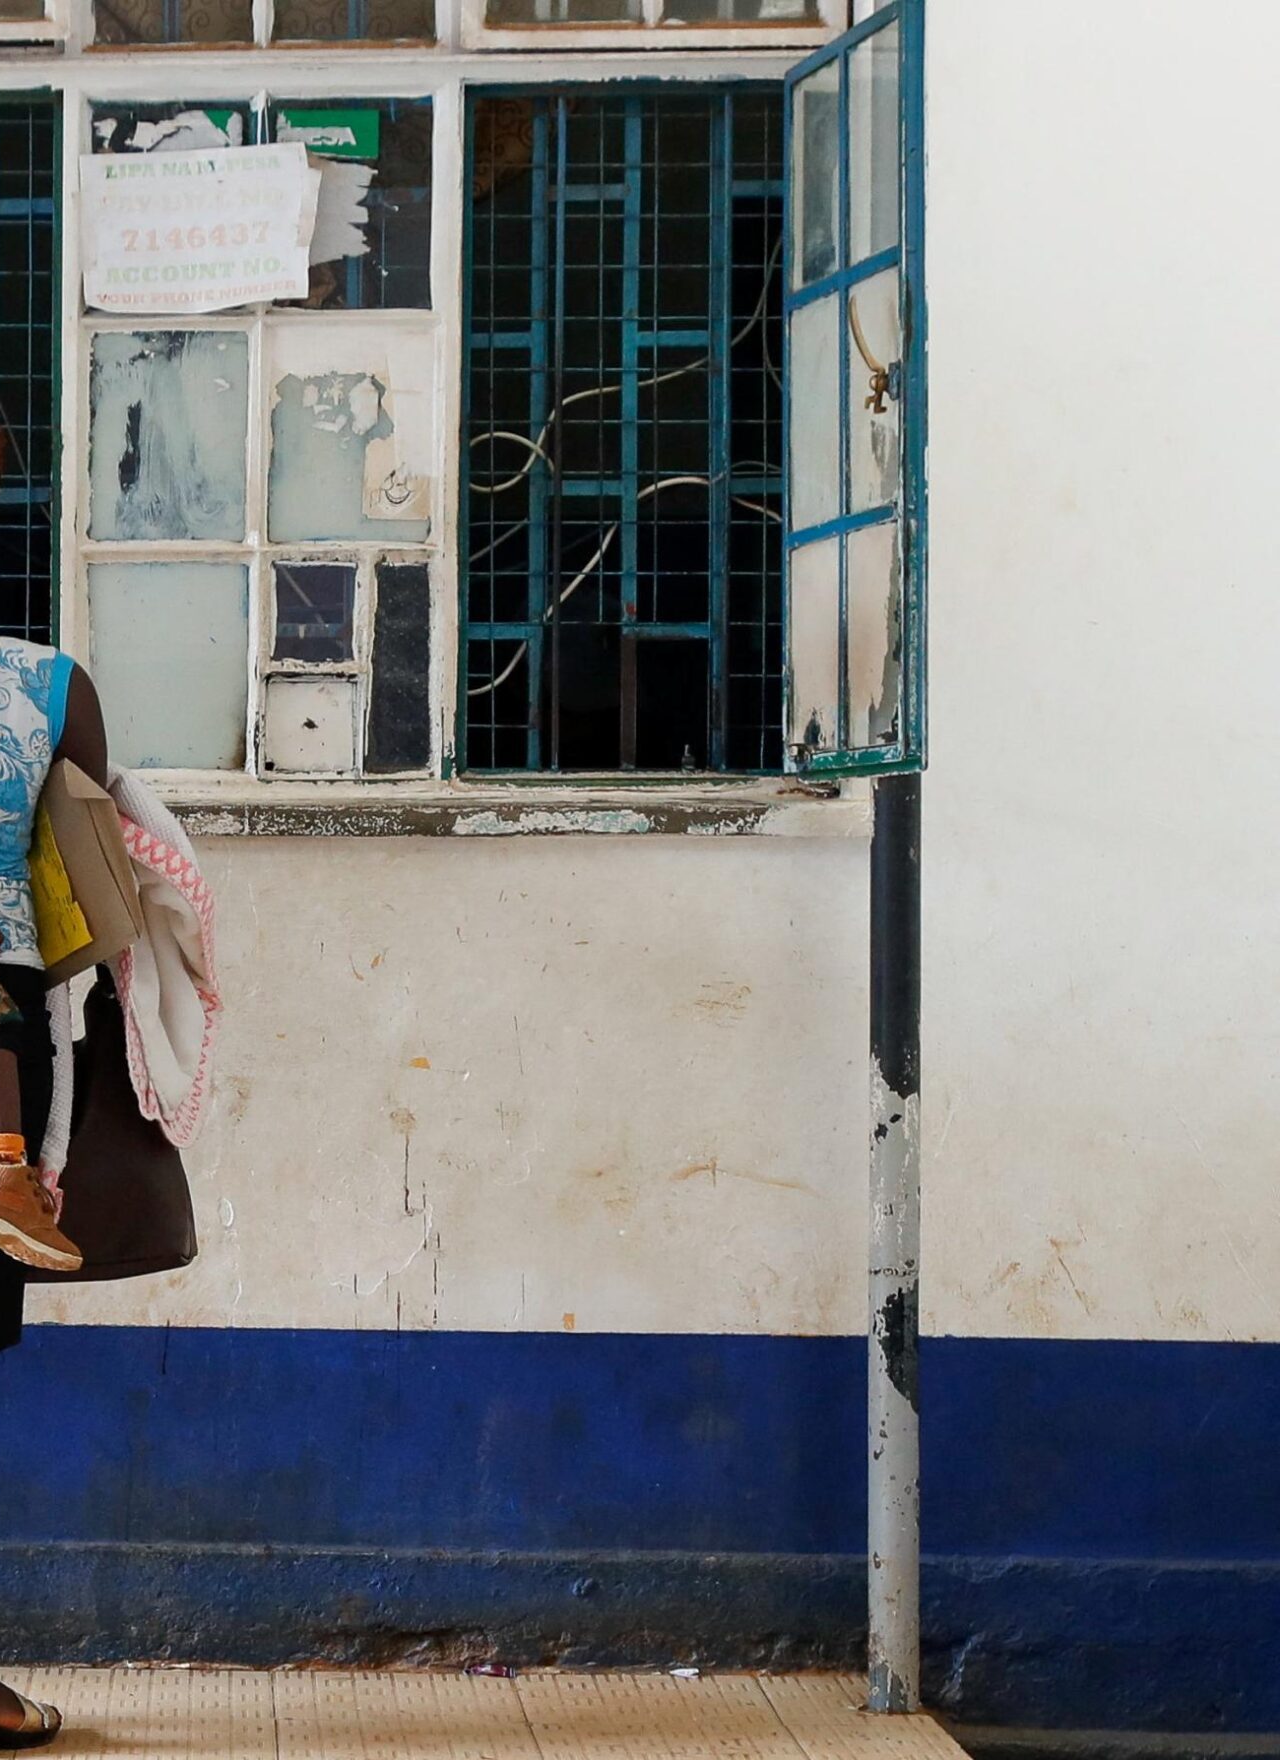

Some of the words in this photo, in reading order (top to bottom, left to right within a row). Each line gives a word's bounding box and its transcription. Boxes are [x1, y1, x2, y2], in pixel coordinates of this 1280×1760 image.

[104, 163, 156, 180] LIPA
[161, 161, 192, 177] NA
[122, 221, 271, 252] 7146437
[106, 261, 236, 284] ACCOUNT
[97, 292, 145, 305] YOUR
[149, 289, 215, 305] PHONE
[219, 278, 297, 299] NUMBER
